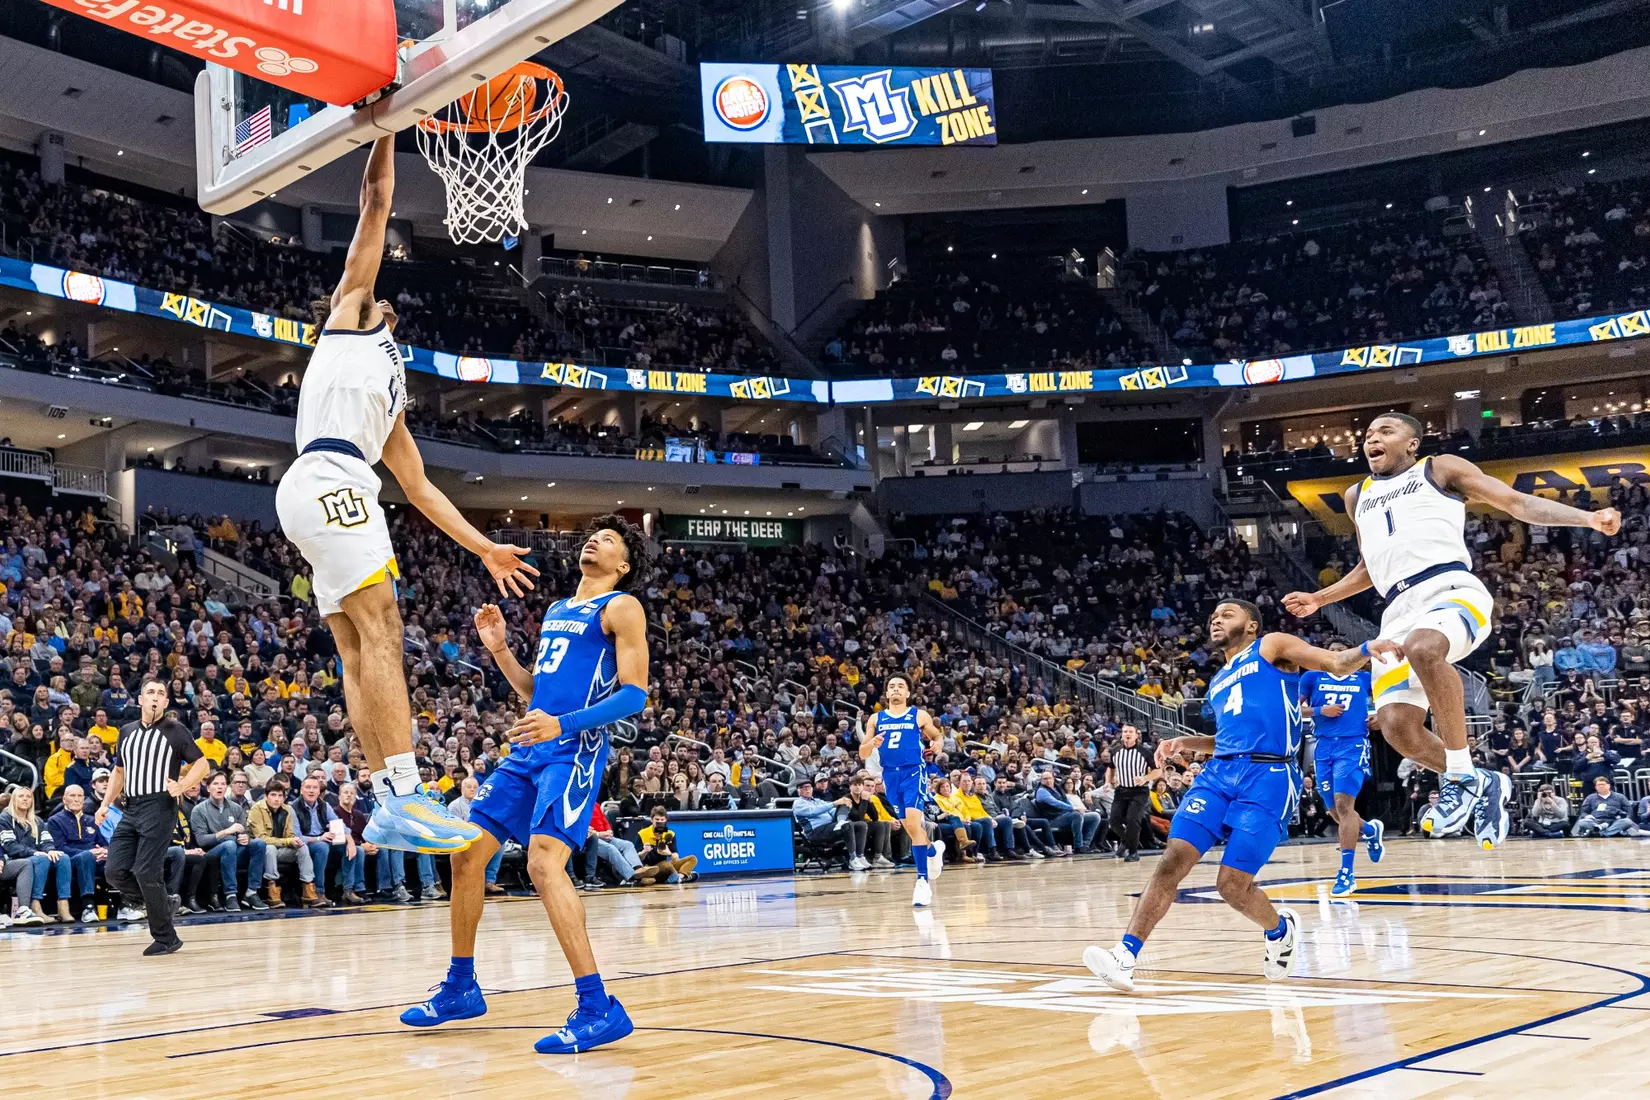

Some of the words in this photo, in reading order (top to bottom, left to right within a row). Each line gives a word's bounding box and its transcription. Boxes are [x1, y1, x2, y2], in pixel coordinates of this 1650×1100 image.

[829, 70, 917, 143] MU
[911, 69, 976, 117] KILL
[936, 105, 996, 146] ZONE
[274, 317, 300, 343] KILL
[1475, 330, 1511, 353] KILL
[1512, 323, 1557, 348] ZONE
[648, 370, 674, 391] KILL
[675, 372, 707, 393] ZONE
[1029, 372, 1057, 392] KILL
[1058, 370, 1093, 391] ZONE
[48, 407, 68, 419] 106
[319, 487, 370, 527] MU
[1358, 480, 1424, 518] Marquette
[688, 519, 721, 537] FEAR
[724, 520, 749, 538] THE
[750, 521, 783, 539] DEER
[1384, 506, 1397, 537] 1
[533, 636, 570, 676] 23
[1223, 682, 1244, 716] 4
[887, 731, 902, 749] 2
[703, 842, 756, 859] GRUBER
